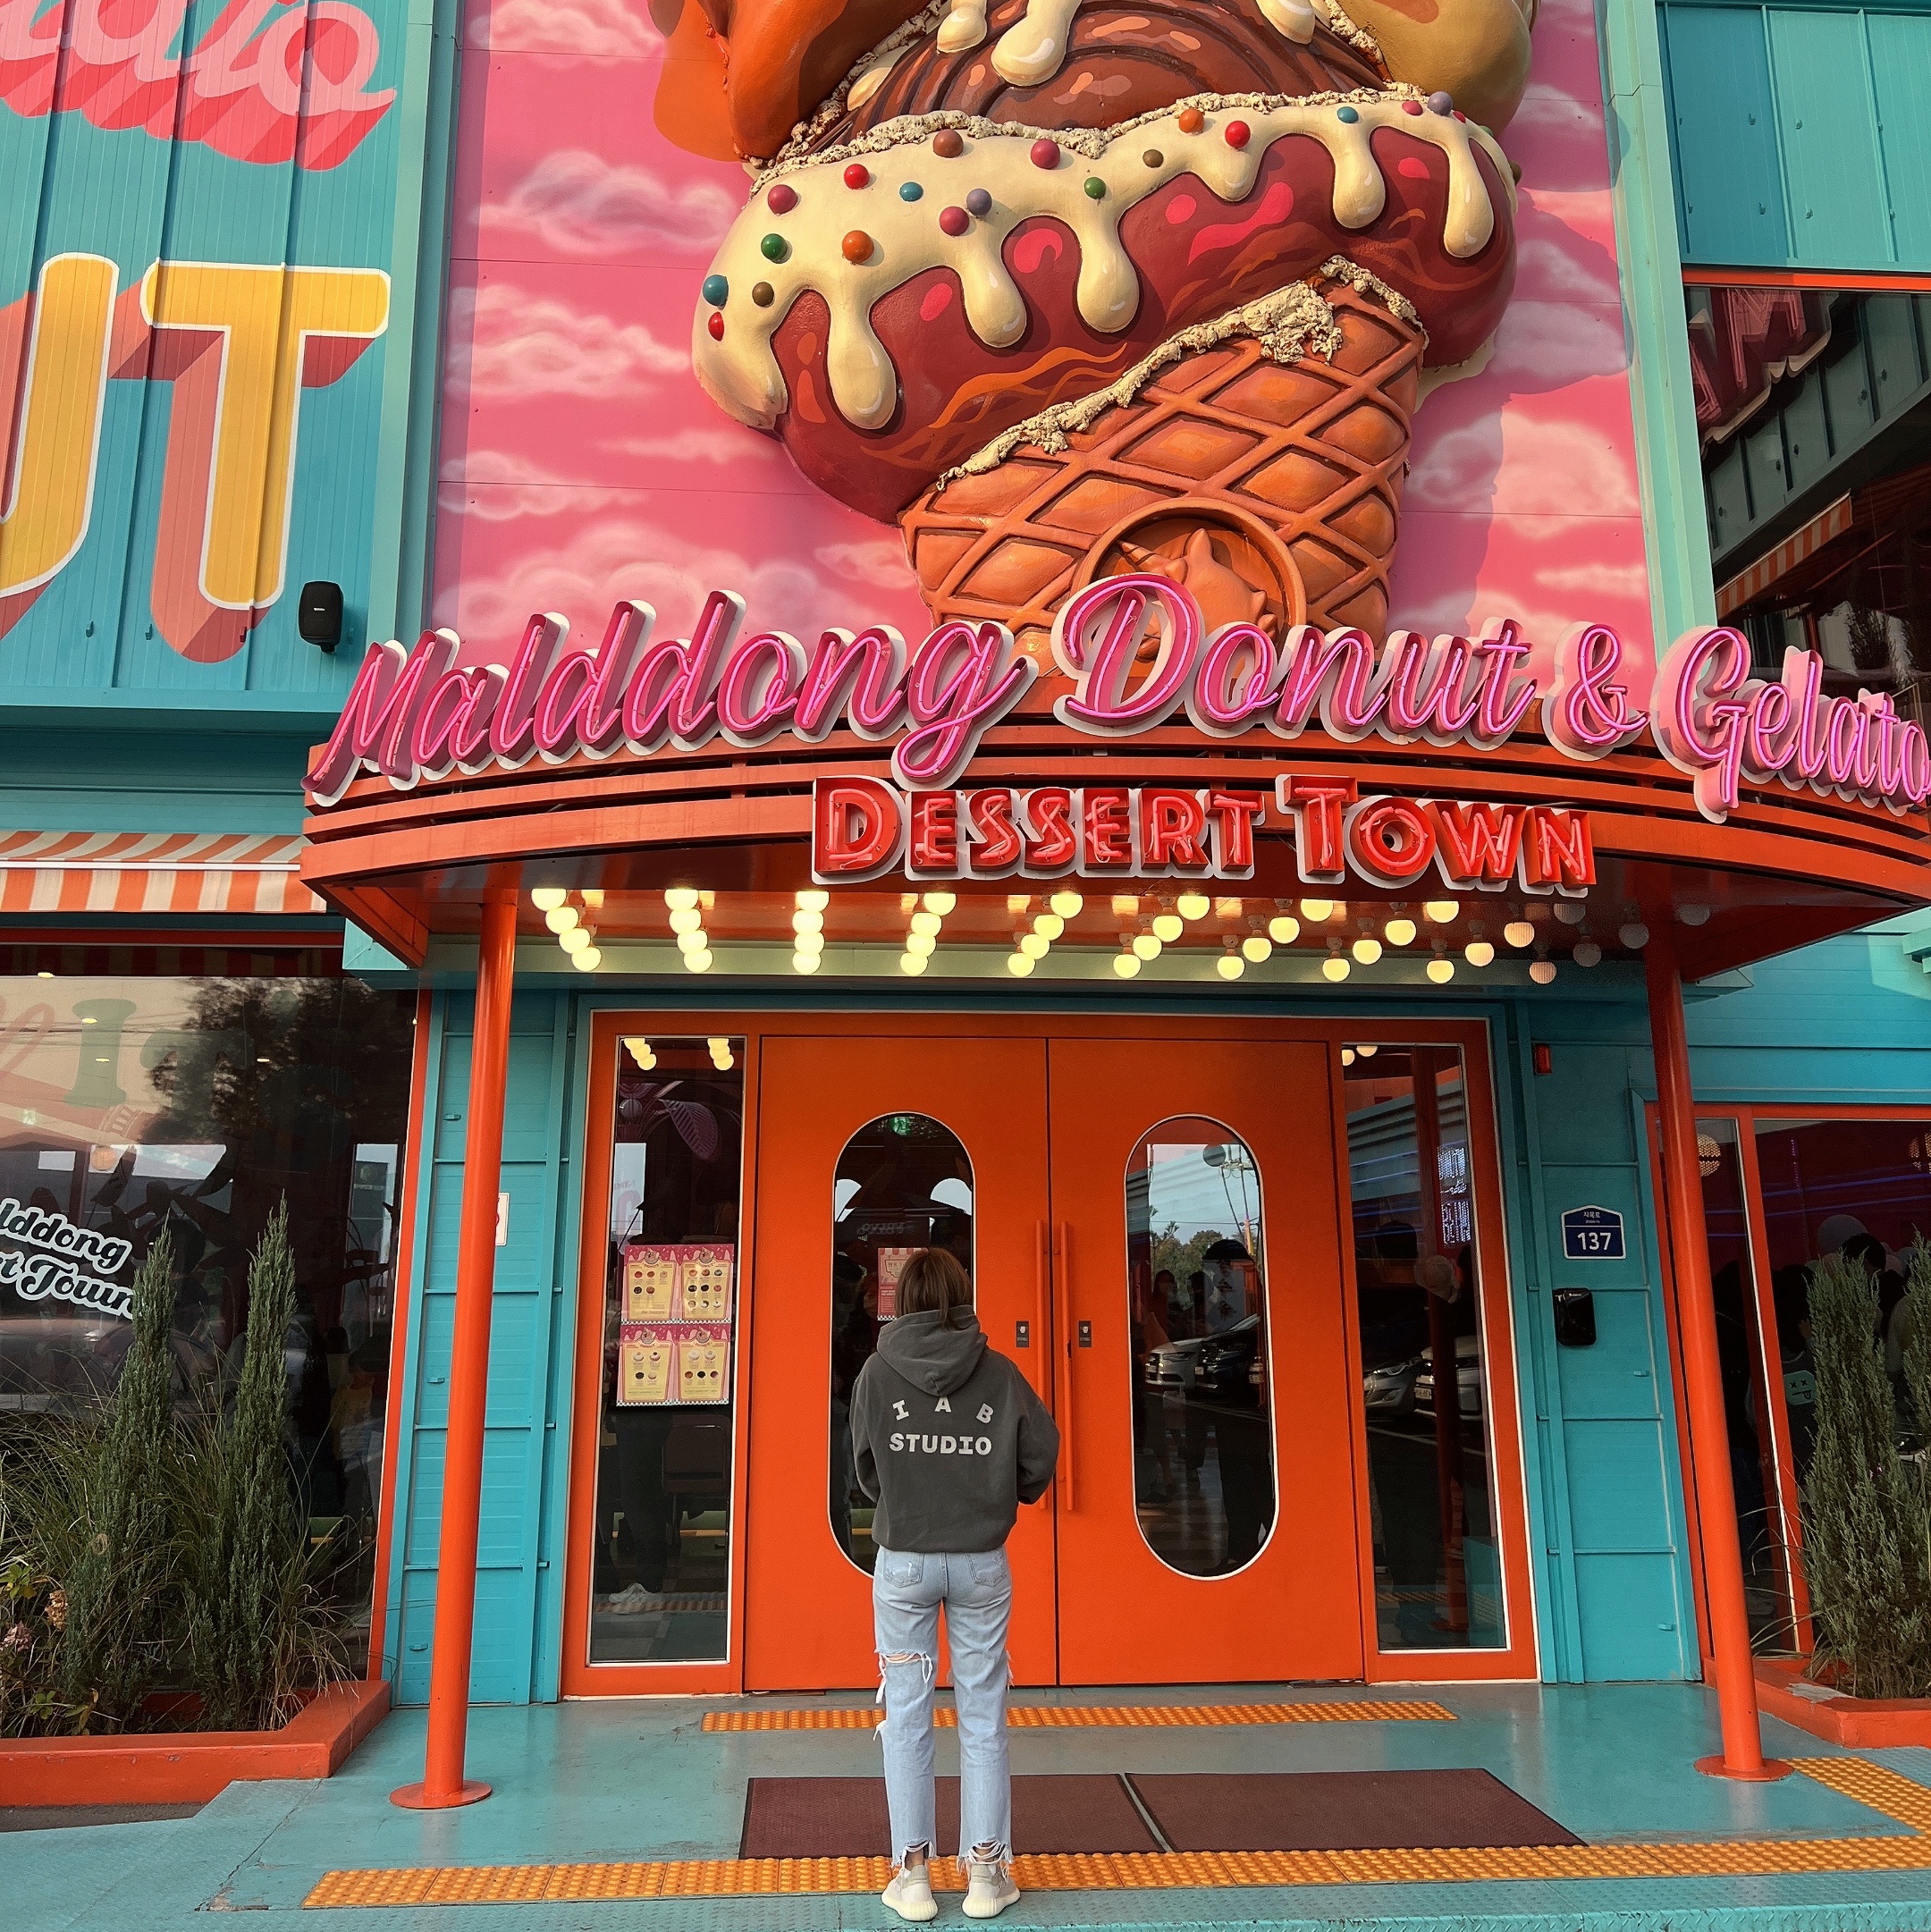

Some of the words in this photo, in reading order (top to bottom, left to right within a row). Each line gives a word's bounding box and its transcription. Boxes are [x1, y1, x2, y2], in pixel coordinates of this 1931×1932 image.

[302, 590, 1035, 789] Malddong
[1055, 574, 1538, 748] Donut
[1554, 622, 1647, 755] &
[1657, 625, 1931, 823] Gelato
[813, 776, 1264, 881] DESSERT
[1277, 774, 1597, 895] TOWN
[1577, 1232, 1612, 1251] 137
[889, 1432, 992, 1456] STUDIO
